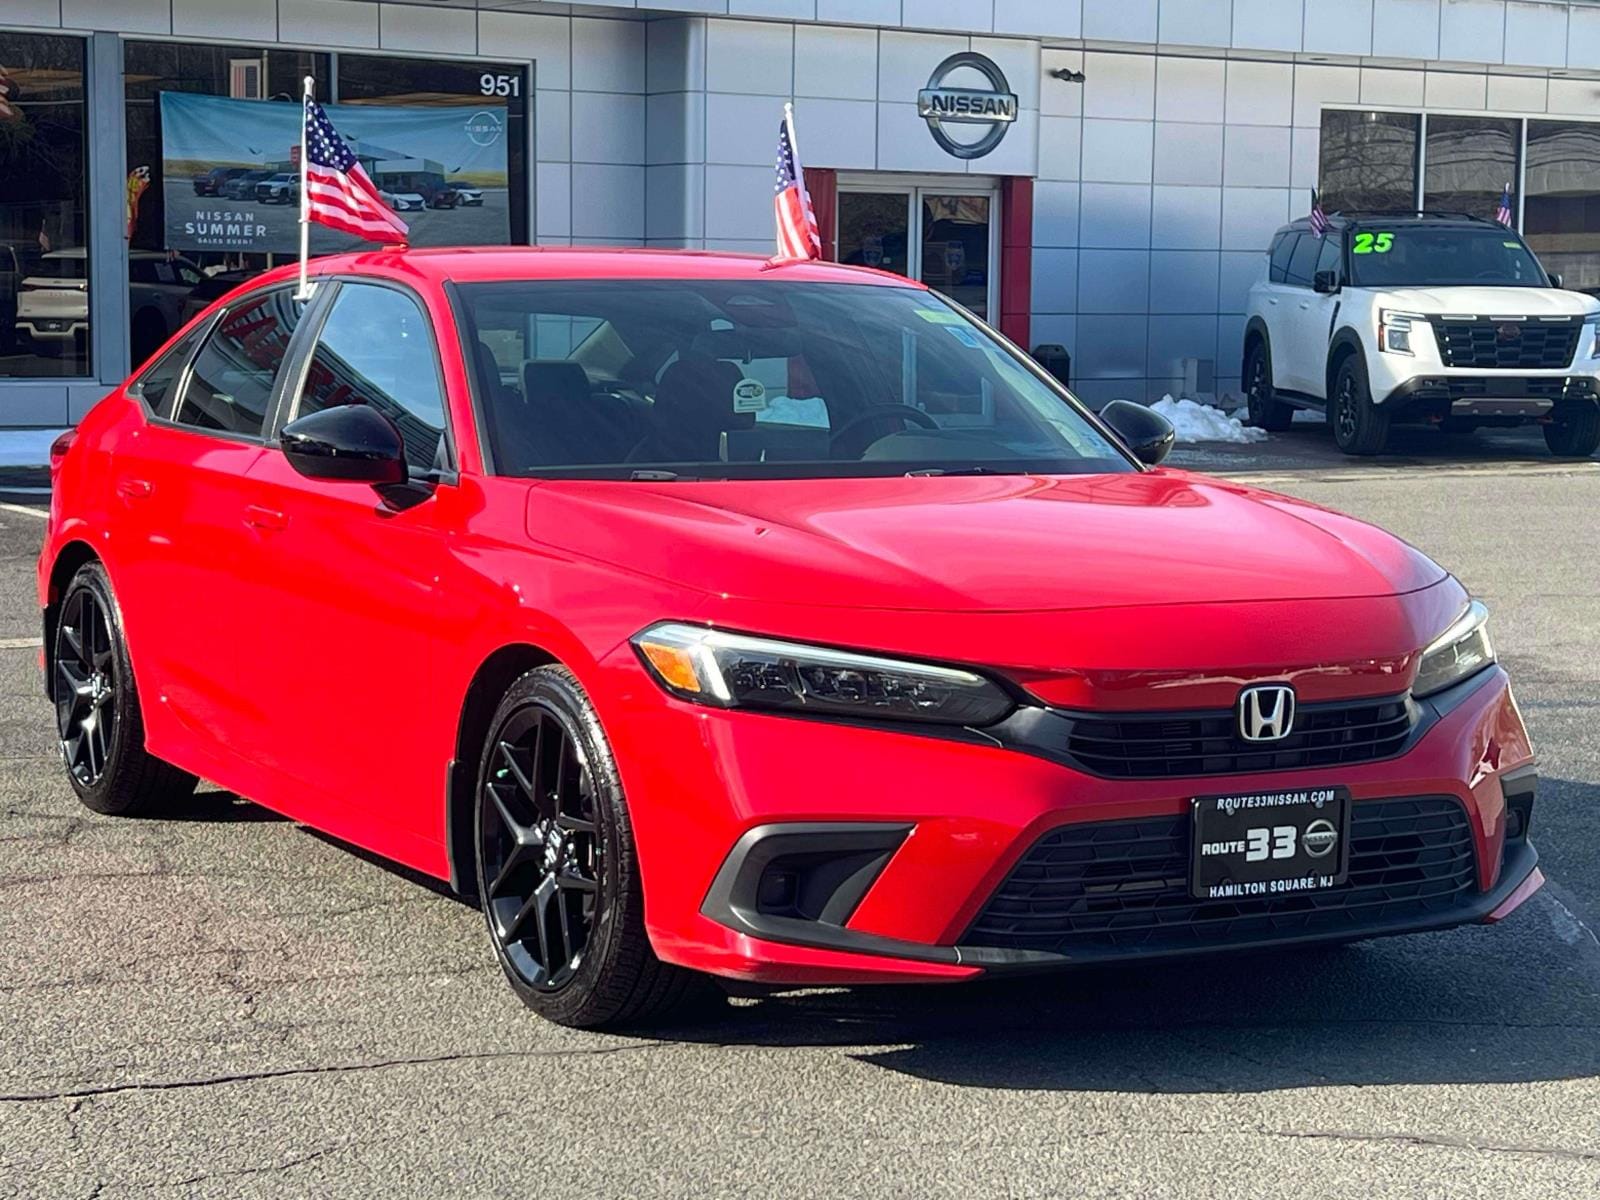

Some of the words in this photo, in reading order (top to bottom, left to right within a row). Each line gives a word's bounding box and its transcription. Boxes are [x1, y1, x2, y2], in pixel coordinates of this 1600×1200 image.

[480, 73, 519, 97] 951
[932, 95, 1010, 116] NISSAN
[196, 211, 254, 221] NISSAN
[185, 222, 267, 237] SUMMER
[1353, 233, 1394, 254] 25
[1217, 790, 1335, 810] ROUTE33NISSAN.COM
[1202, 840, 1245, 856] ROUTE
[1246, 825, 1297, 862] 33
[1303, 834, 1337, 844] NISSAN
[1209, 882, 1266, 898] HAMILTON
[1320, 875, 1333, 888] NJ
